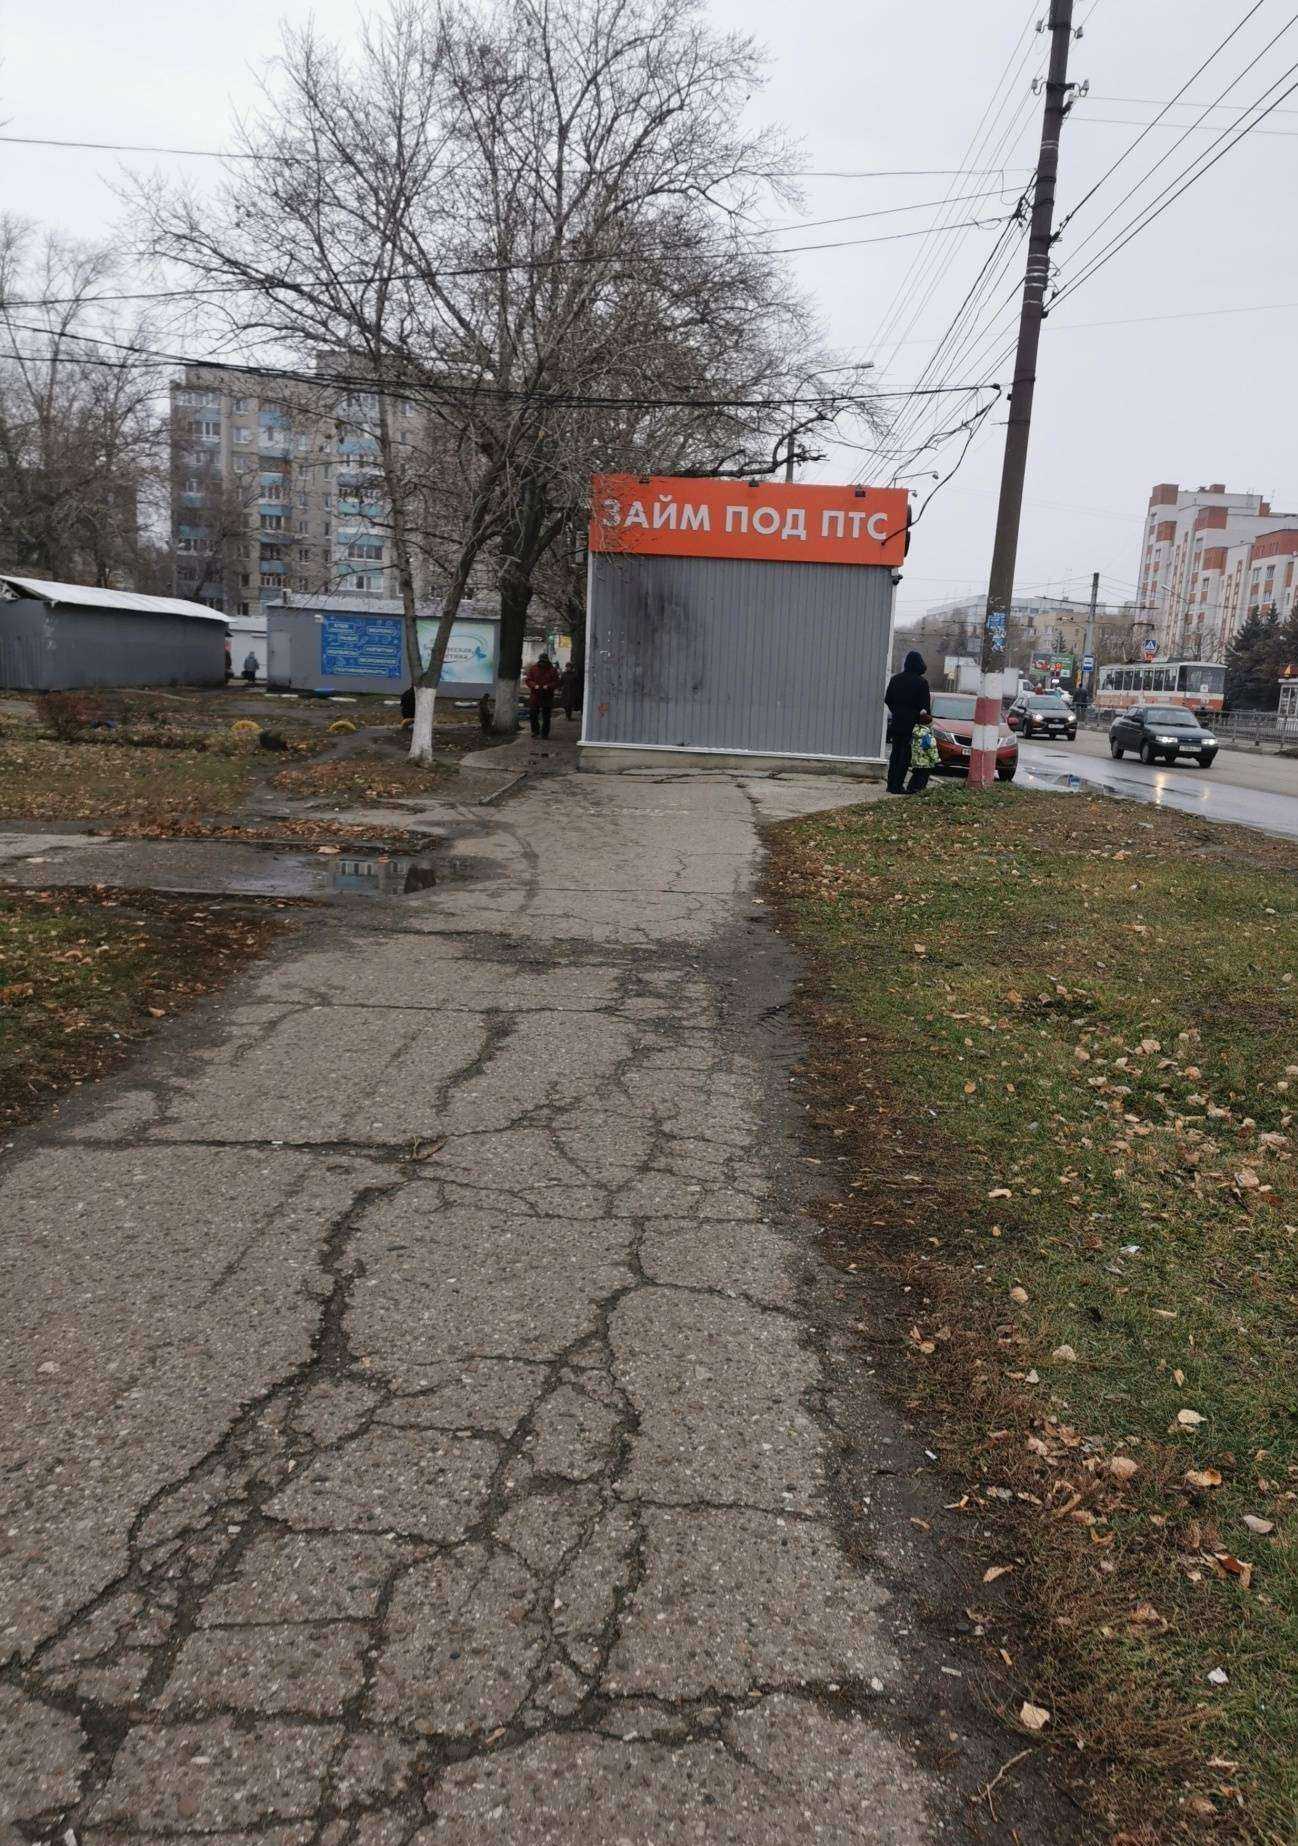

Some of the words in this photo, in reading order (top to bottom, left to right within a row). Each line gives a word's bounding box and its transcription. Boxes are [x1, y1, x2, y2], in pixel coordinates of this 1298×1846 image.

[602, 494, 711, 531] ЗАЙМ
[725, 505, 807, 541] ПОД
[821, 510, 888, 541] ПТС
